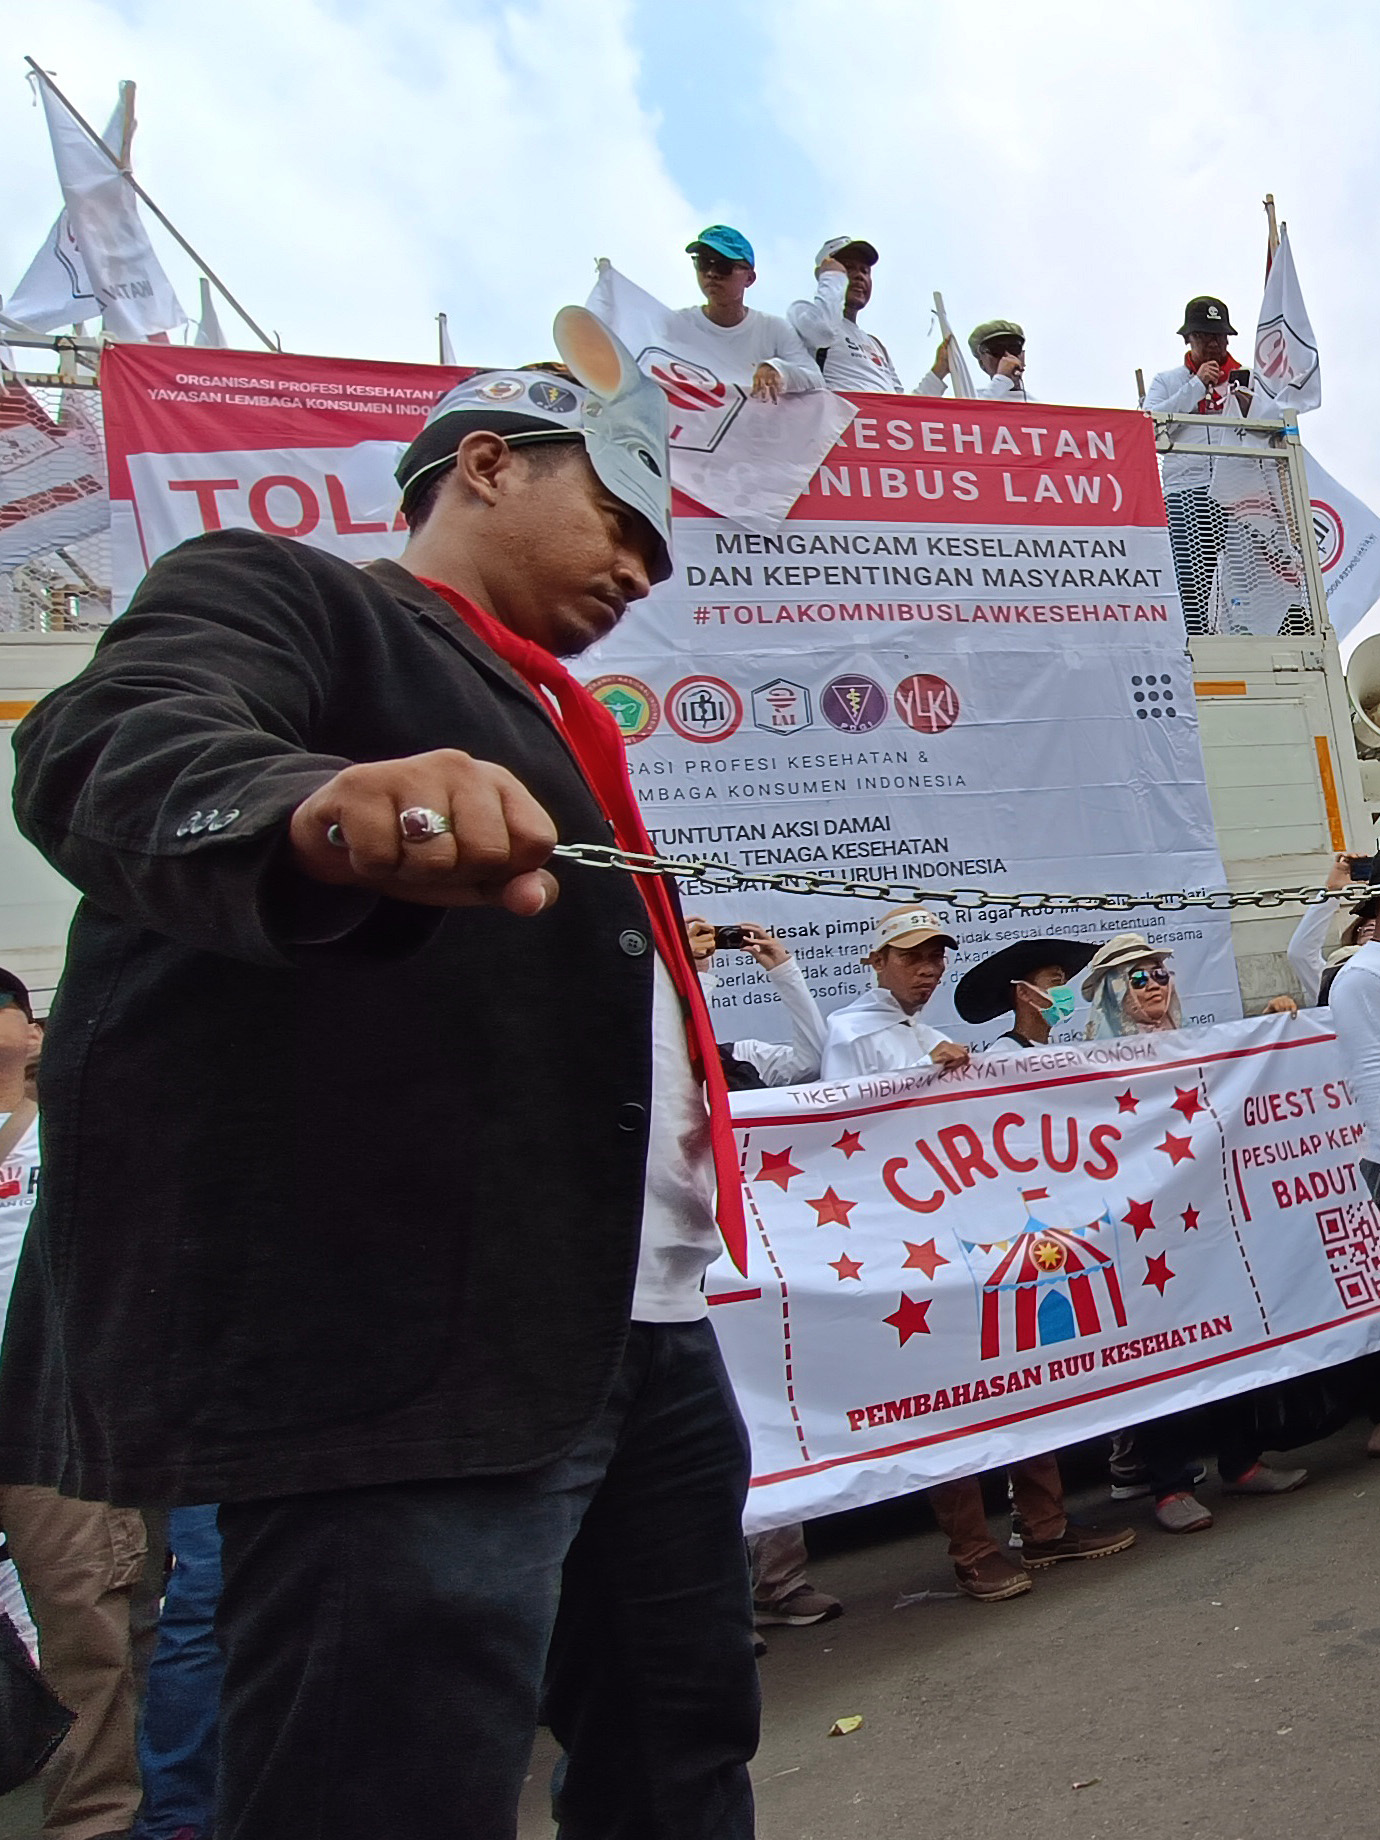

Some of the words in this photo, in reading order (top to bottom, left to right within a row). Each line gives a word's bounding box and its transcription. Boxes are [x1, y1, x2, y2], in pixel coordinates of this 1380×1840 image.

[175, 373, 275, 390] ORGANISASI
[278, 381, 343, 395] PROFESI
[346, 385, 434, 399] KESEHATAN
[148, 389, 222, 404] YAYASAN
[225, 393, 302, 409] LEMBAGA
[305, 398, 393, 414] KONSUMEN
[1002, 472, 1123, 512] LAW)
[715, 533, 918, 556] MENGANCAM
[926, 537, 1127, 559] KESELAMATAN
[686, 566, 753, 587] DAN
[763, 565, 971, 588] KEPENTINGAN
[982, 567, 1163, 588] MASYARAKAT
[693, 603, 1168, 625] #TOLAKOMNIBUSLAWKESEHATAN
[896, 676, 956, 732] YLKI
[685, 757, 777, 774] PROFESI
[788, 751, 909, 769] KESEHATAN
[917, 750, 929, 762] &
[728, 779, 846, 798] KONSUMEN
[857, 775, 967, 791] INDONESIA
[649, 823, 767, 846] TUNTUTAN
[772, 822, 819, 839] AKSI
[824, 815, 891, 836] DAMAI
[739, 846, 828, 866] TENAGA
[832, 837, 950, 860] KESEHATAN
[903, 858, 1008, 879] INDONESIA
[978, 907, 1014, 923] agar
[794, 945, 834, 960] tidak
[995, 925, 1042, 941] sesuai
[1046, 920, 1097, 937] dengan
[1100, 915, 1166, 931] ketentuan
[1147, 928, 1203, 945] bersama
[787, 1085, 850, 1106] TIKET
[1015, 1052, 1083, 1074] NEGERI
[1243, 1086, 1316, 1127] GUEST
[882, 1112, 1122, 1214] CIRCUS
[1242, 1134, 1322, 1169] PESULAP
[1271, 1163, 1357, 1210] BADUT
[845, 1364, 1042, 1433] PEMBAHASAN
[1047, 1352, 1096, 1383] RUU
[1100, 1315, 1233, 1368] KESEHATAN
